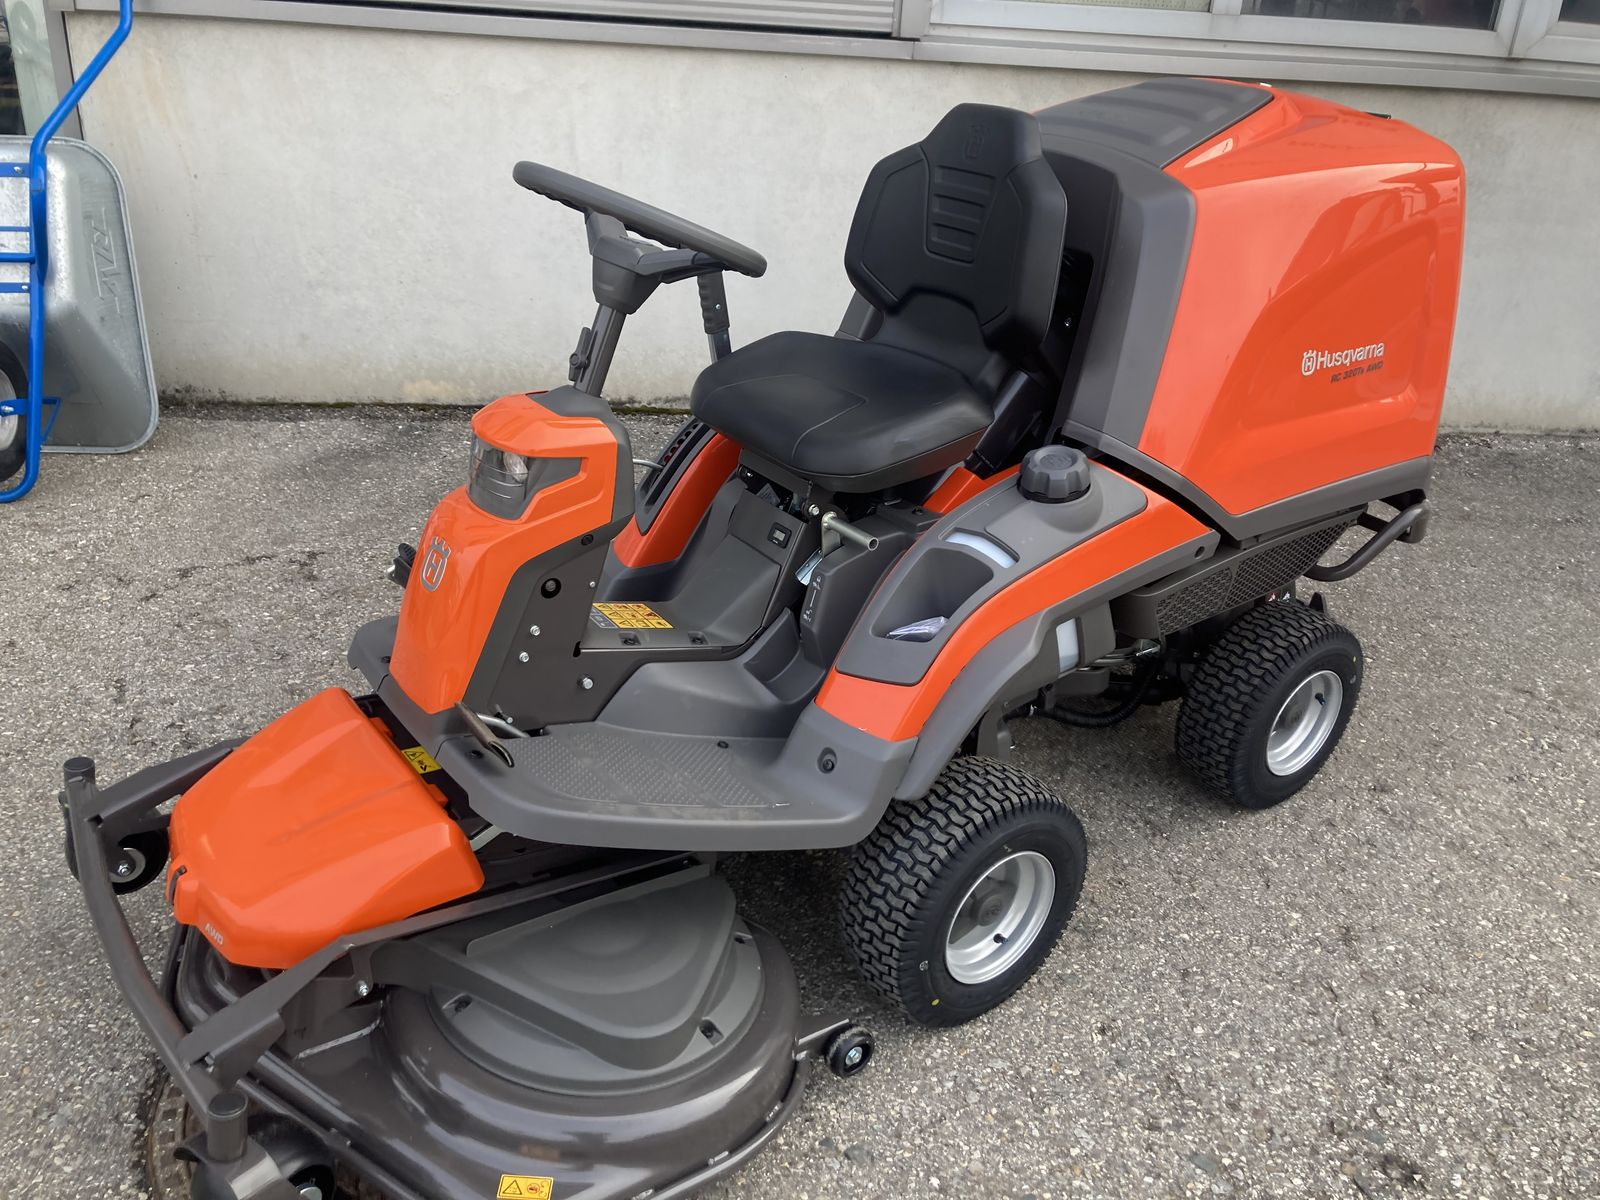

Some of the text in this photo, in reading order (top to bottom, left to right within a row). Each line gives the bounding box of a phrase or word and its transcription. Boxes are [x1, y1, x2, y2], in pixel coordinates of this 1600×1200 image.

[1316, 342, 1385, 370] Husqvarna
[1366, 360, 1384, 373] AWD
[204, 922, 225, 946] AWD
